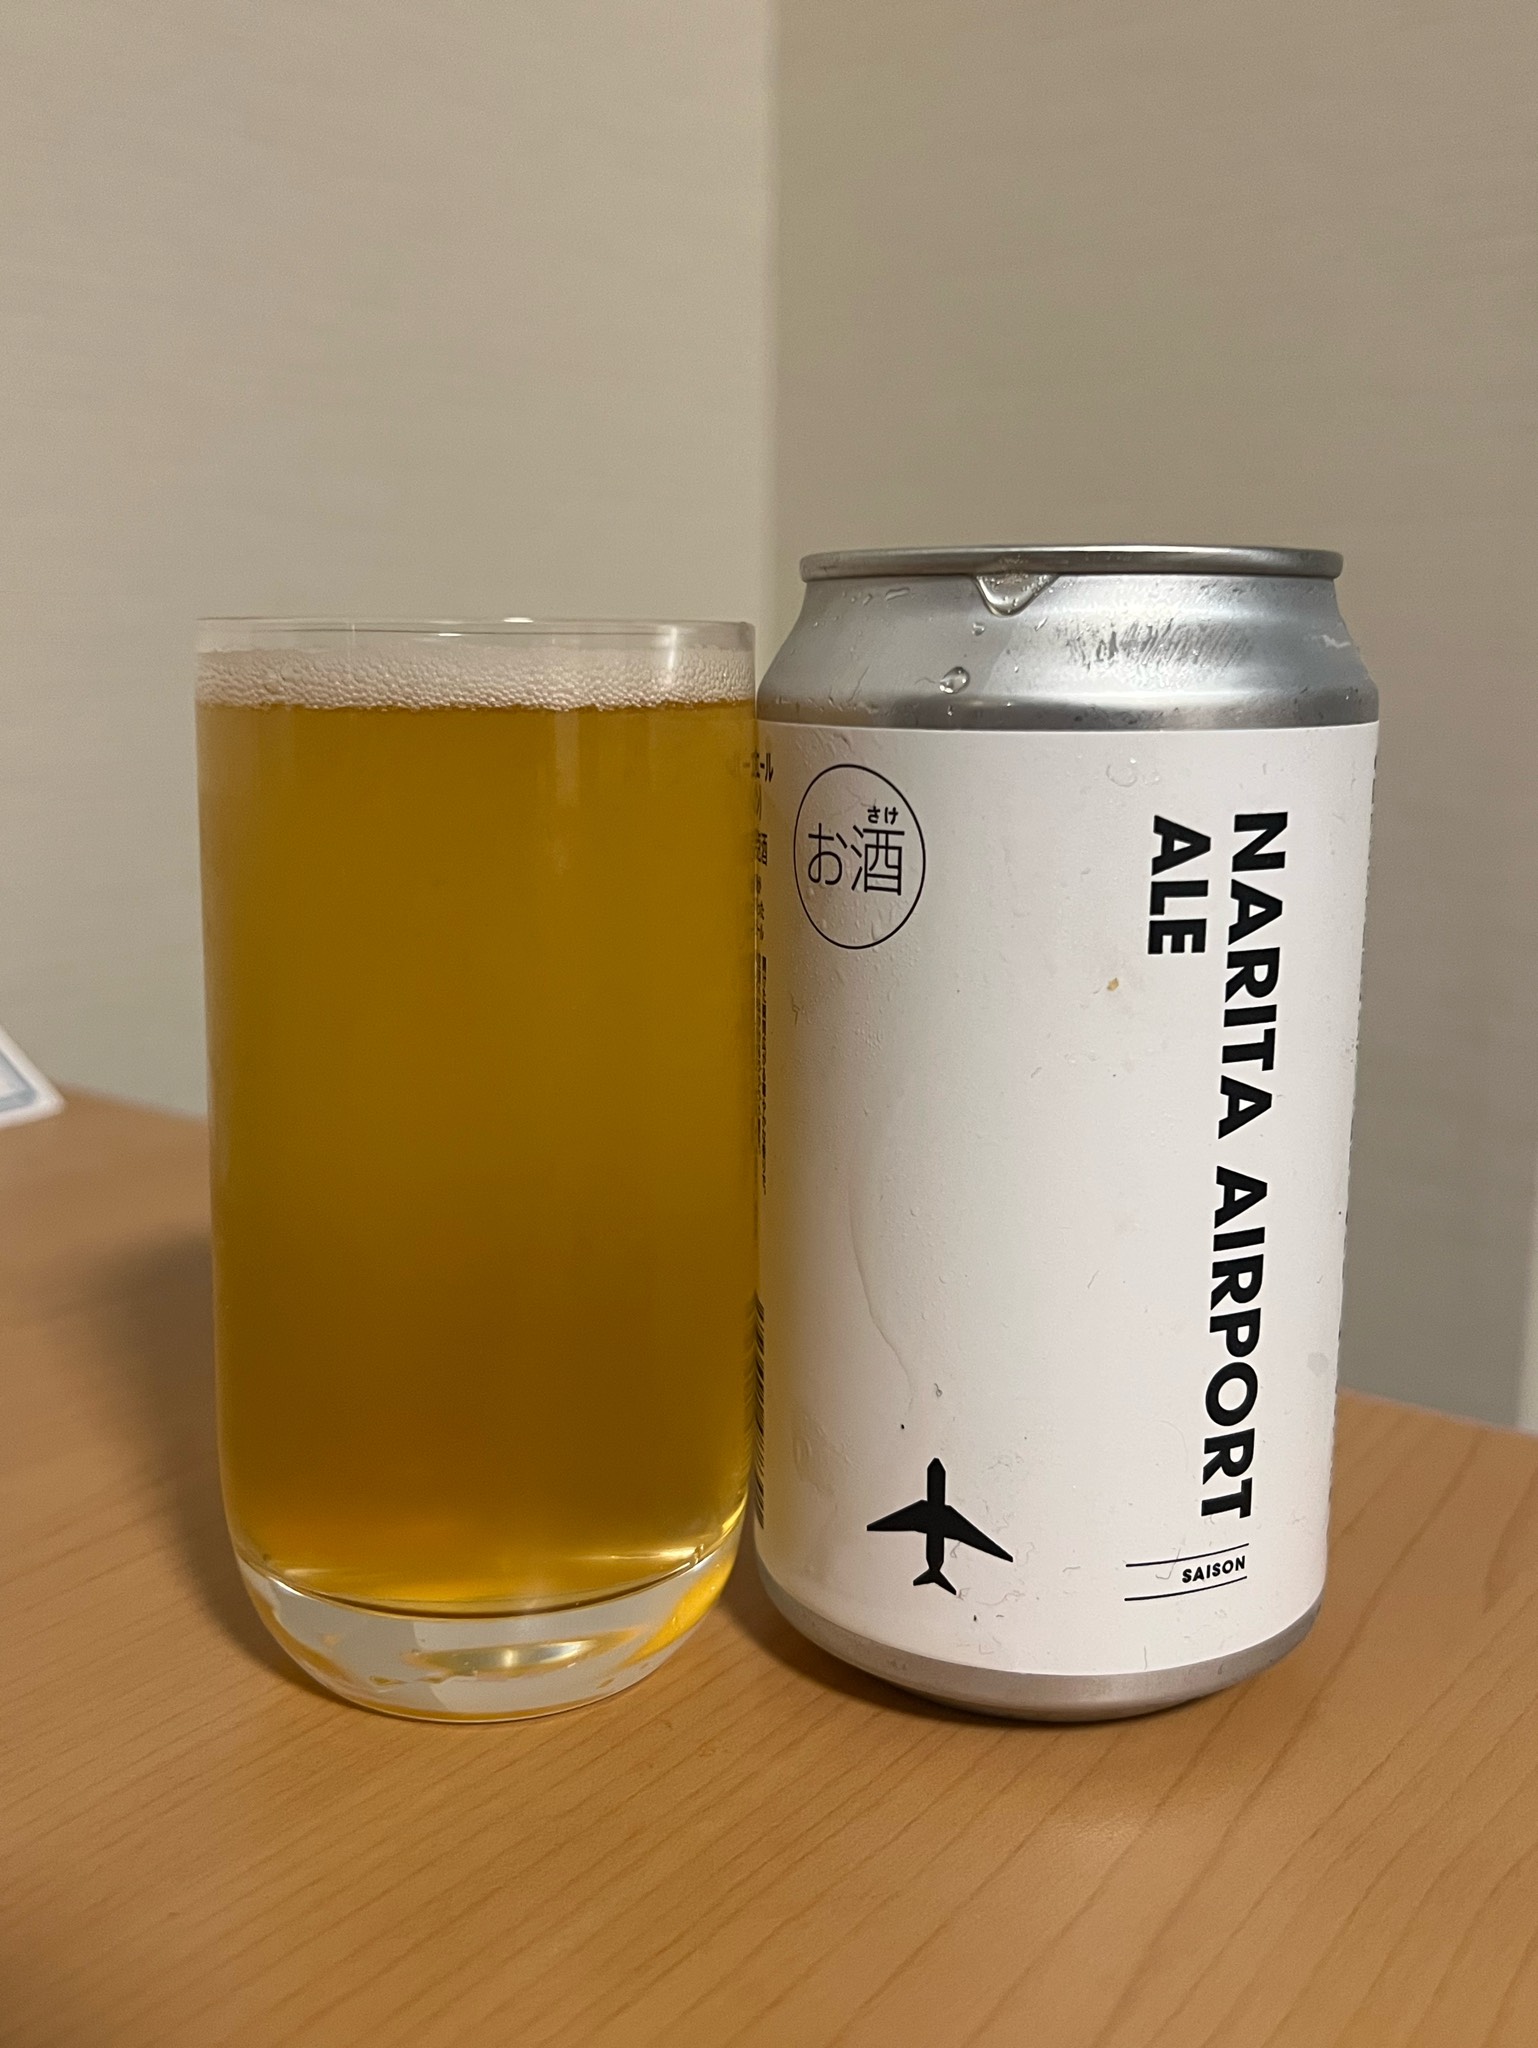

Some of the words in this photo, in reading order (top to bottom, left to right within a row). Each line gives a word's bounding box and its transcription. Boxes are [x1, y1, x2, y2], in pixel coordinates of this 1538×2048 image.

[807, 822, 905, 897] お酒
[867, 804, 899, 825] さけ
[1147, 815, 1212, 955] ALE
[1218, 811, 1288, 1140] NARITA
[1201, 1165, 1268, 1519] AIRPORT
[1182, 1555, 1246, 1584] SAISON
